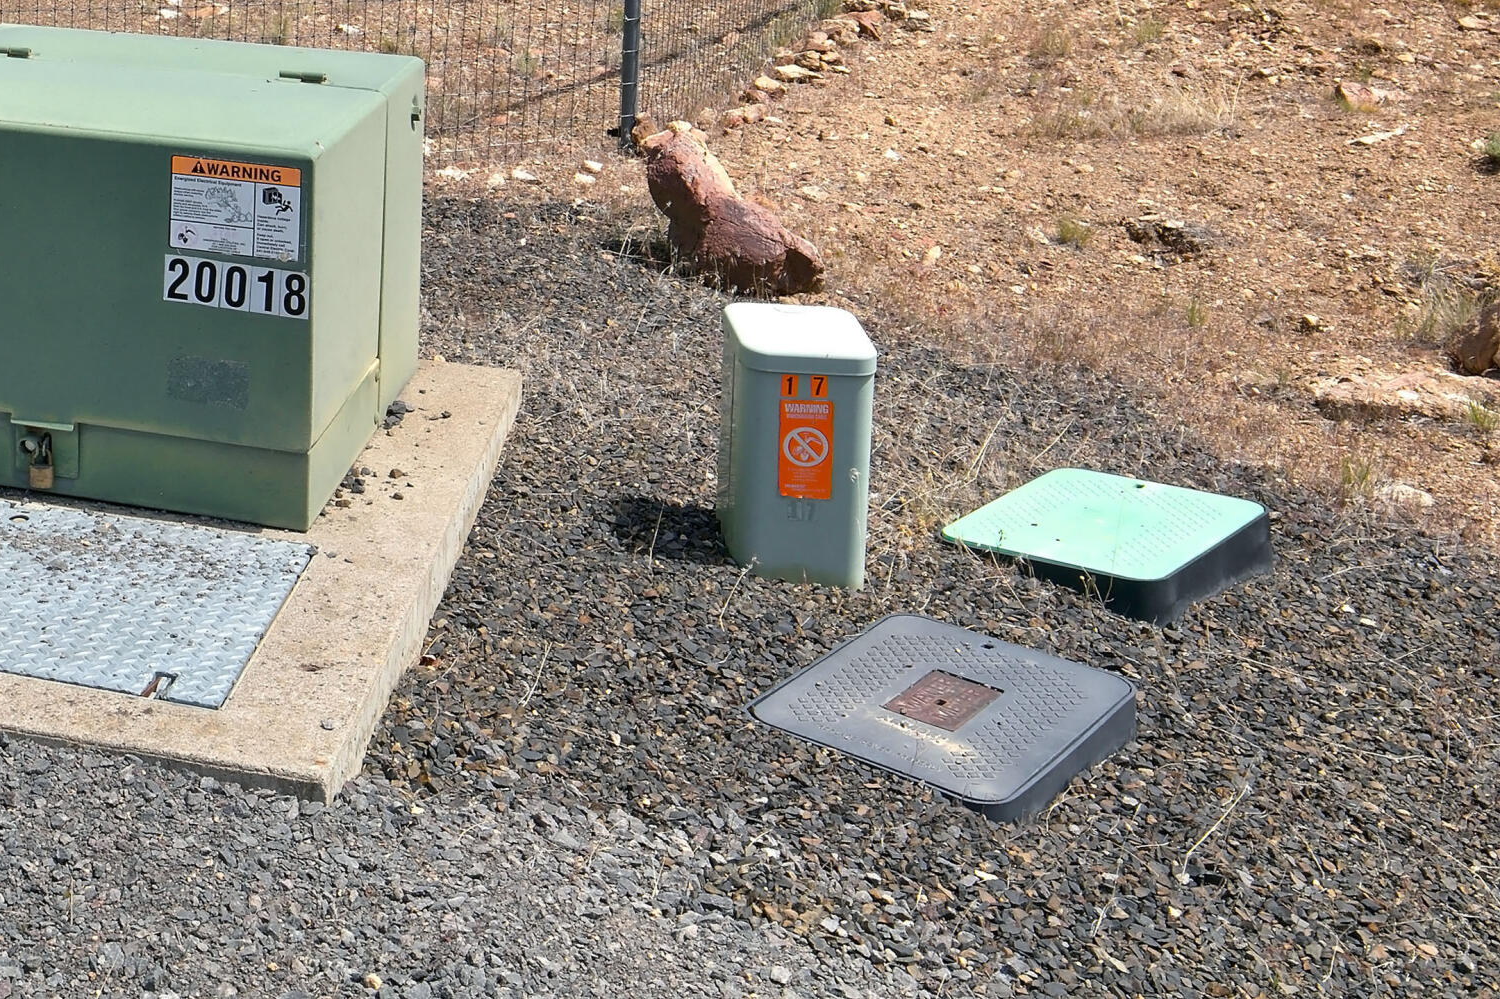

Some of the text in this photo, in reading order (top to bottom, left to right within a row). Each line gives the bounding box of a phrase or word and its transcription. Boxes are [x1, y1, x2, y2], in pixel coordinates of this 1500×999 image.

[207, 161, 281, 182] WARNING
[167, 258, 306, 316] 20018
[784, 403, 829, 414] WARNING
